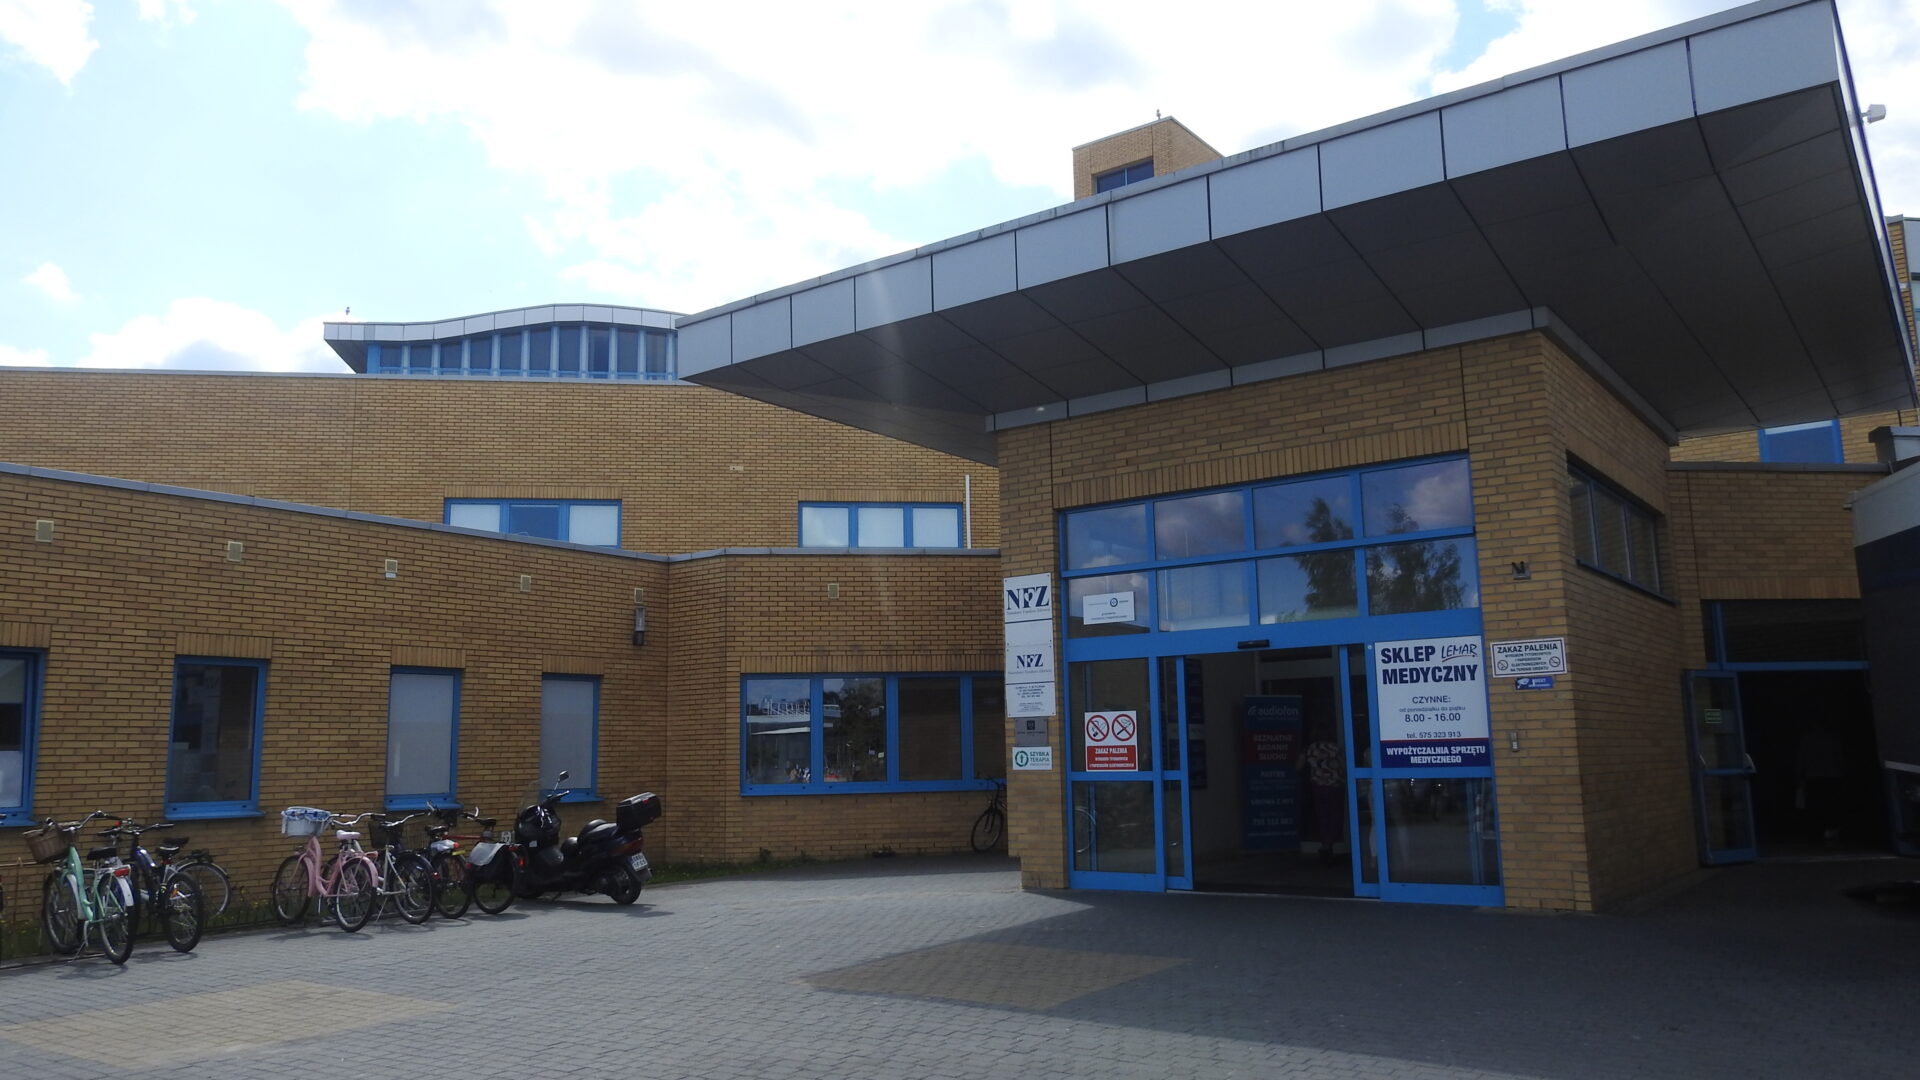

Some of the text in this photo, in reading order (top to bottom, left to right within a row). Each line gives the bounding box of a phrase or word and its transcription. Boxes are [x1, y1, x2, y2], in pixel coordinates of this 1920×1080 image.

[1006, 586, 1050, 610] NFZ
[1381, 644, 1478, 664] SKLEP LEMAR
[1497, 643, 1558, 654] ZAKAZ PALENIA
[1016, 653, 1044, 669] NFZ
[1382, 664, 1478, 685] MEDYCZNY
[1412, 695, 1451, 704] CZYNNE:
[1405, 713, 1425, 723] 8.00
[1435, 712, 1461, 722] 16.00
[1407, 731, 1418, 739] tel.
[1386, 745, 1486, 756] WYPOŻYCZALNIA SPRZĘTU
[1410, 755, 1462, 764] MEDYCZNEGO
